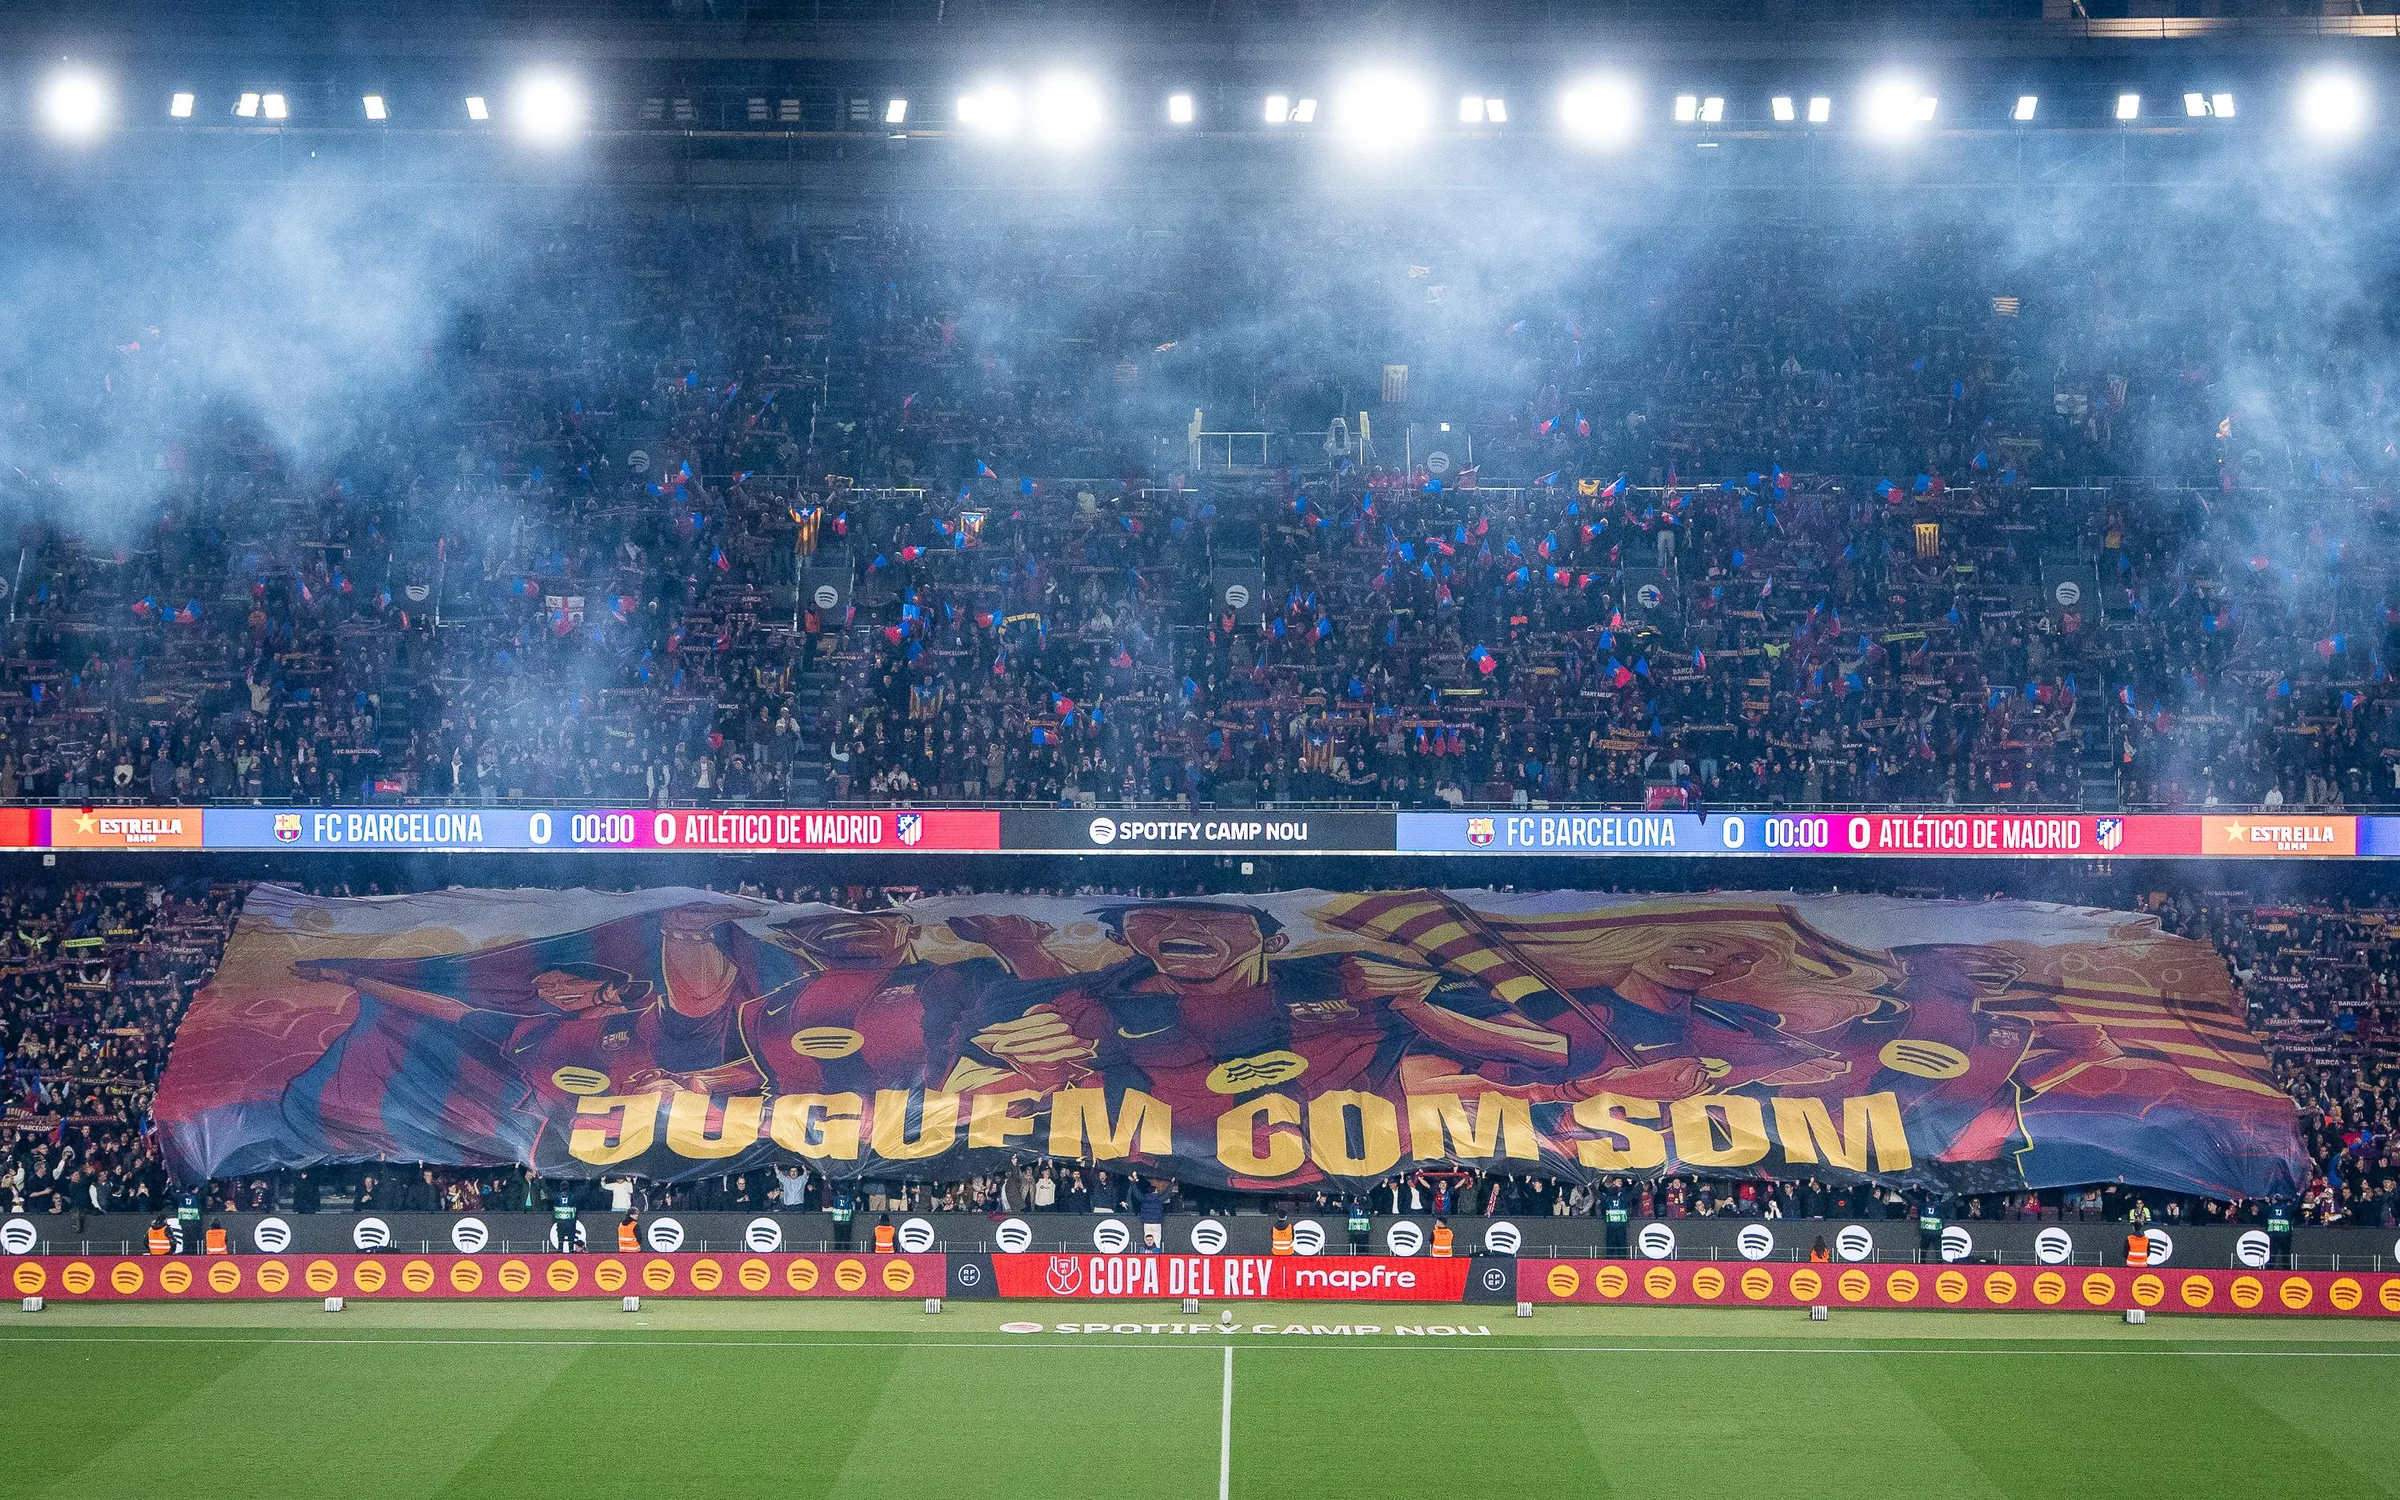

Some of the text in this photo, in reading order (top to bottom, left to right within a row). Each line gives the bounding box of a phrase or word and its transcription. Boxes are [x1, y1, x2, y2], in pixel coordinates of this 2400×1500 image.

[99, 818, 182, 834] ESTRELLA
[125, 834, 157, 843] DAMM
[314, 813, 483, 842] FC BARCELONA
[529, 812, 552, 844] 0
[572, 814, 634, 843] 00:00
[654, 812, 676, 844] 0
[685, 810, 882, 844] ATLÉTICO DE MADRID
[1119, 821, 1308, 841] SPOTIFY CAMP NOU
[1508, 817, 1675, 847] FC BARCELONA
[1723, 816, 1745, 848] 0
[1765, 818, 1828, 847] 00:00
[1849, 817, 1871, 849] 0
[1879, 815, 2081, 849] ATLÉTICO DE MADRID
[2250, 826, 2335, 842] ESTRELLA
[2277, 842, 2308, 851] DAMM
[21, 1123, 53, 1132] BARCELON
[1215, 1089, 1541, 1177] COM
[1573, 1090, 1912, 1173] SOM
[1089, 1256, 1273, 1296] COPA DEL REY
[1296, 1265, 1416, 1292] mapfre
[1054, 1323, 1492, 1336] SPOTIFY CAMP NOU
